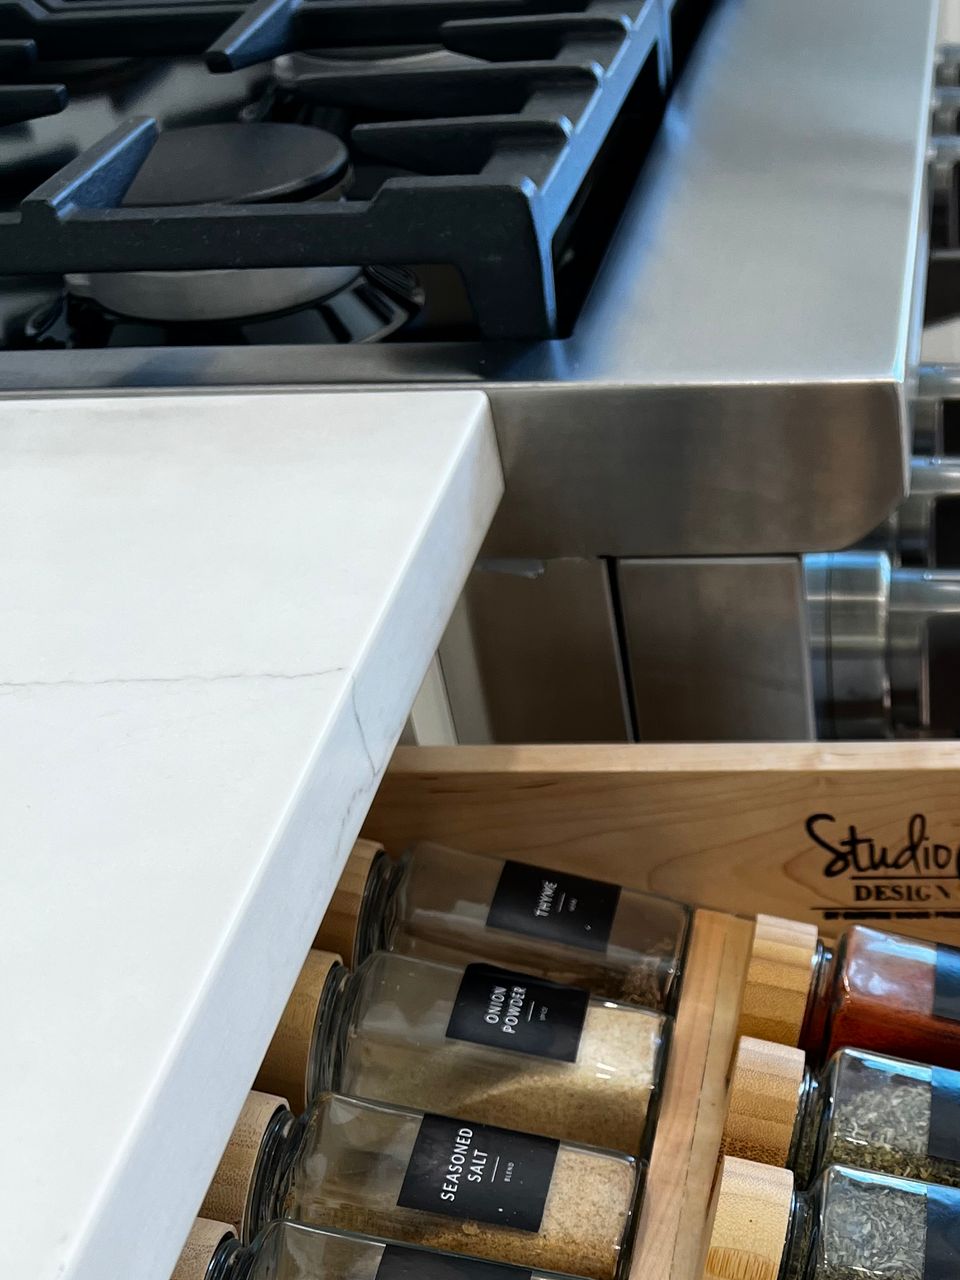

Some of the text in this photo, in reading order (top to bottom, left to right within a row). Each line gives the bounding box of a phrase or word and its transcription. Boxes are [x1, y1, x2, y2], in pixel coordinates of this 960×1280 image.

[805, 813, 952, 878] Studio
[534, 880, 558, 917] THYME
[853, 884, 951, 902] DESIGN
[483, 986, 507, 1024] ONION
[501, 986, 526, 1034] POWDER
[440, 1128, 473, 1202] SEASONED
[467, 1148, 488, 1183] SALT
